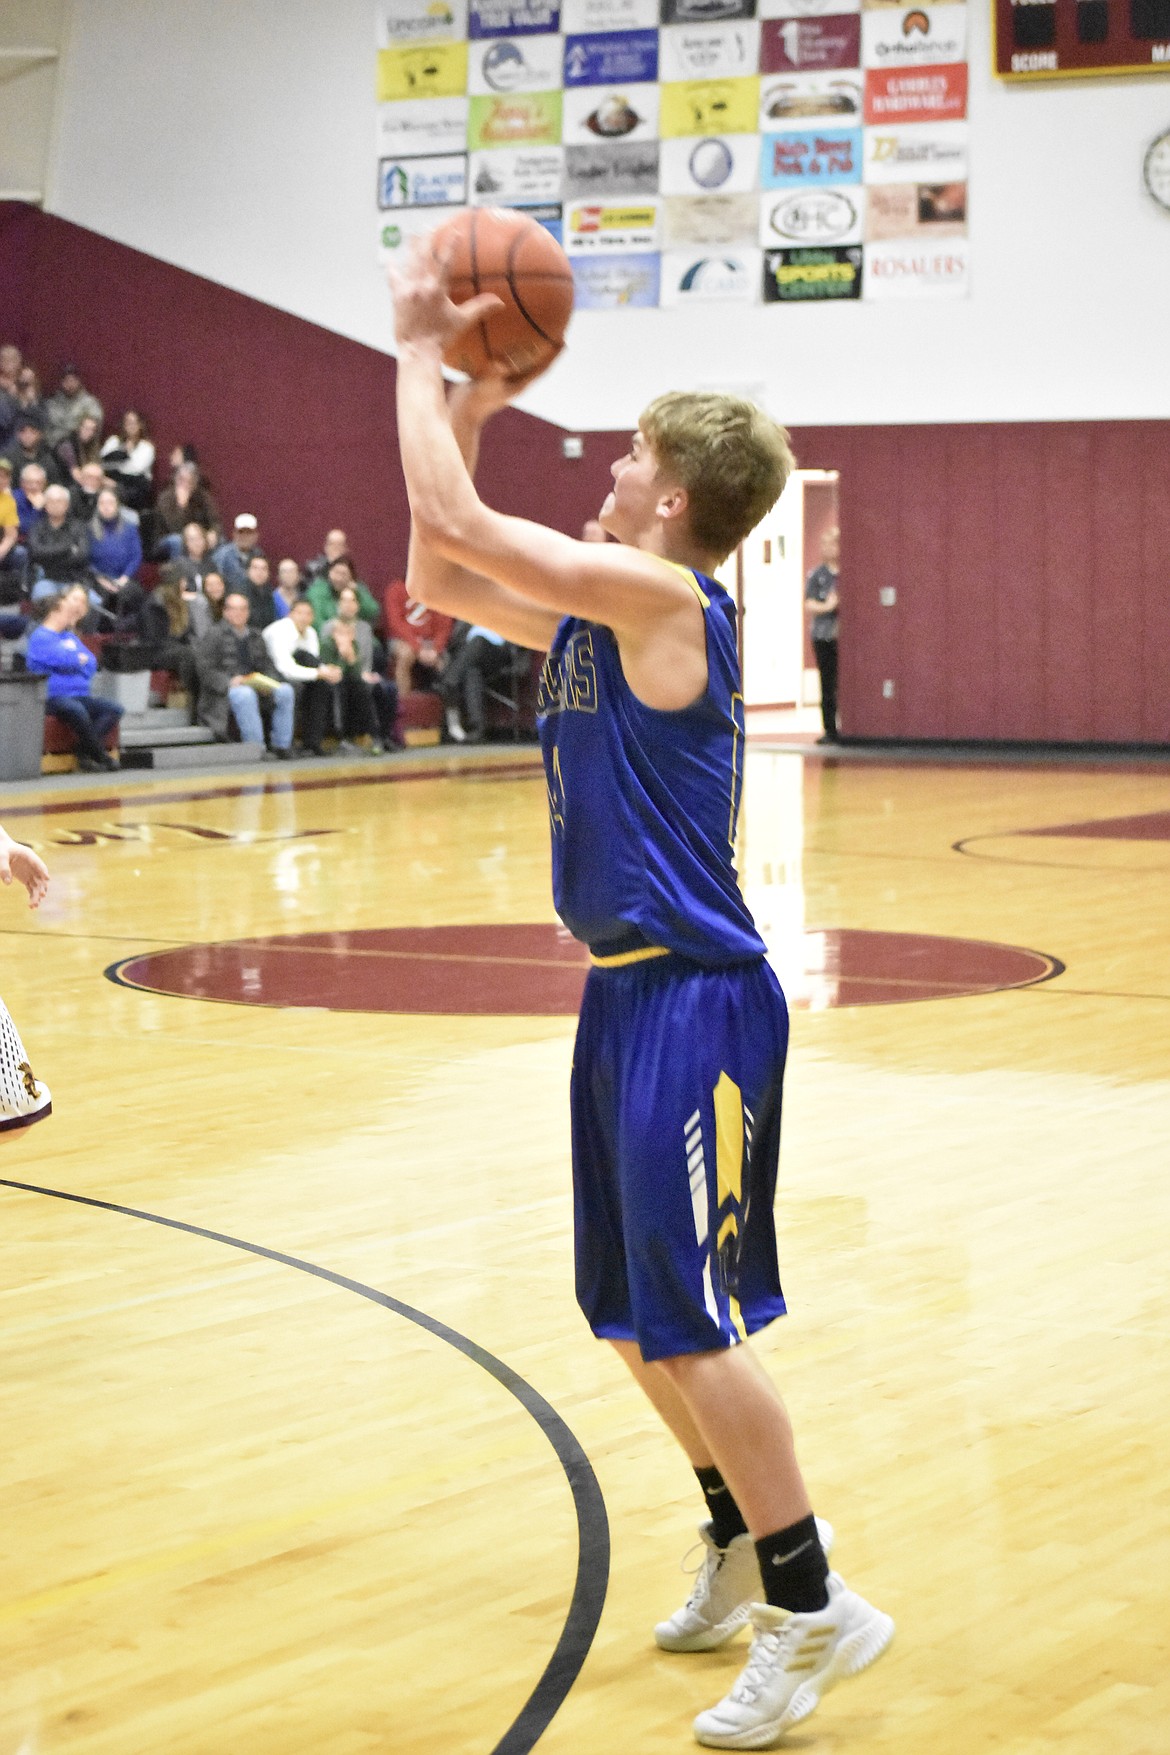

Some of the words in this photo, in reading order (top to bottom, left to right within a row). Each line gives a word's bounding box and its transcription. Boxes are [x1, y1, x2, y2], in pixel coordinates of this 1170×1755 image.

[1011, 51, 1058, 72] SCORE
[776, 262, 855, 284] SPORTS
[872, 255, 966, 277] ROSAUERS
[778, 280, 853, 298] CENTER
